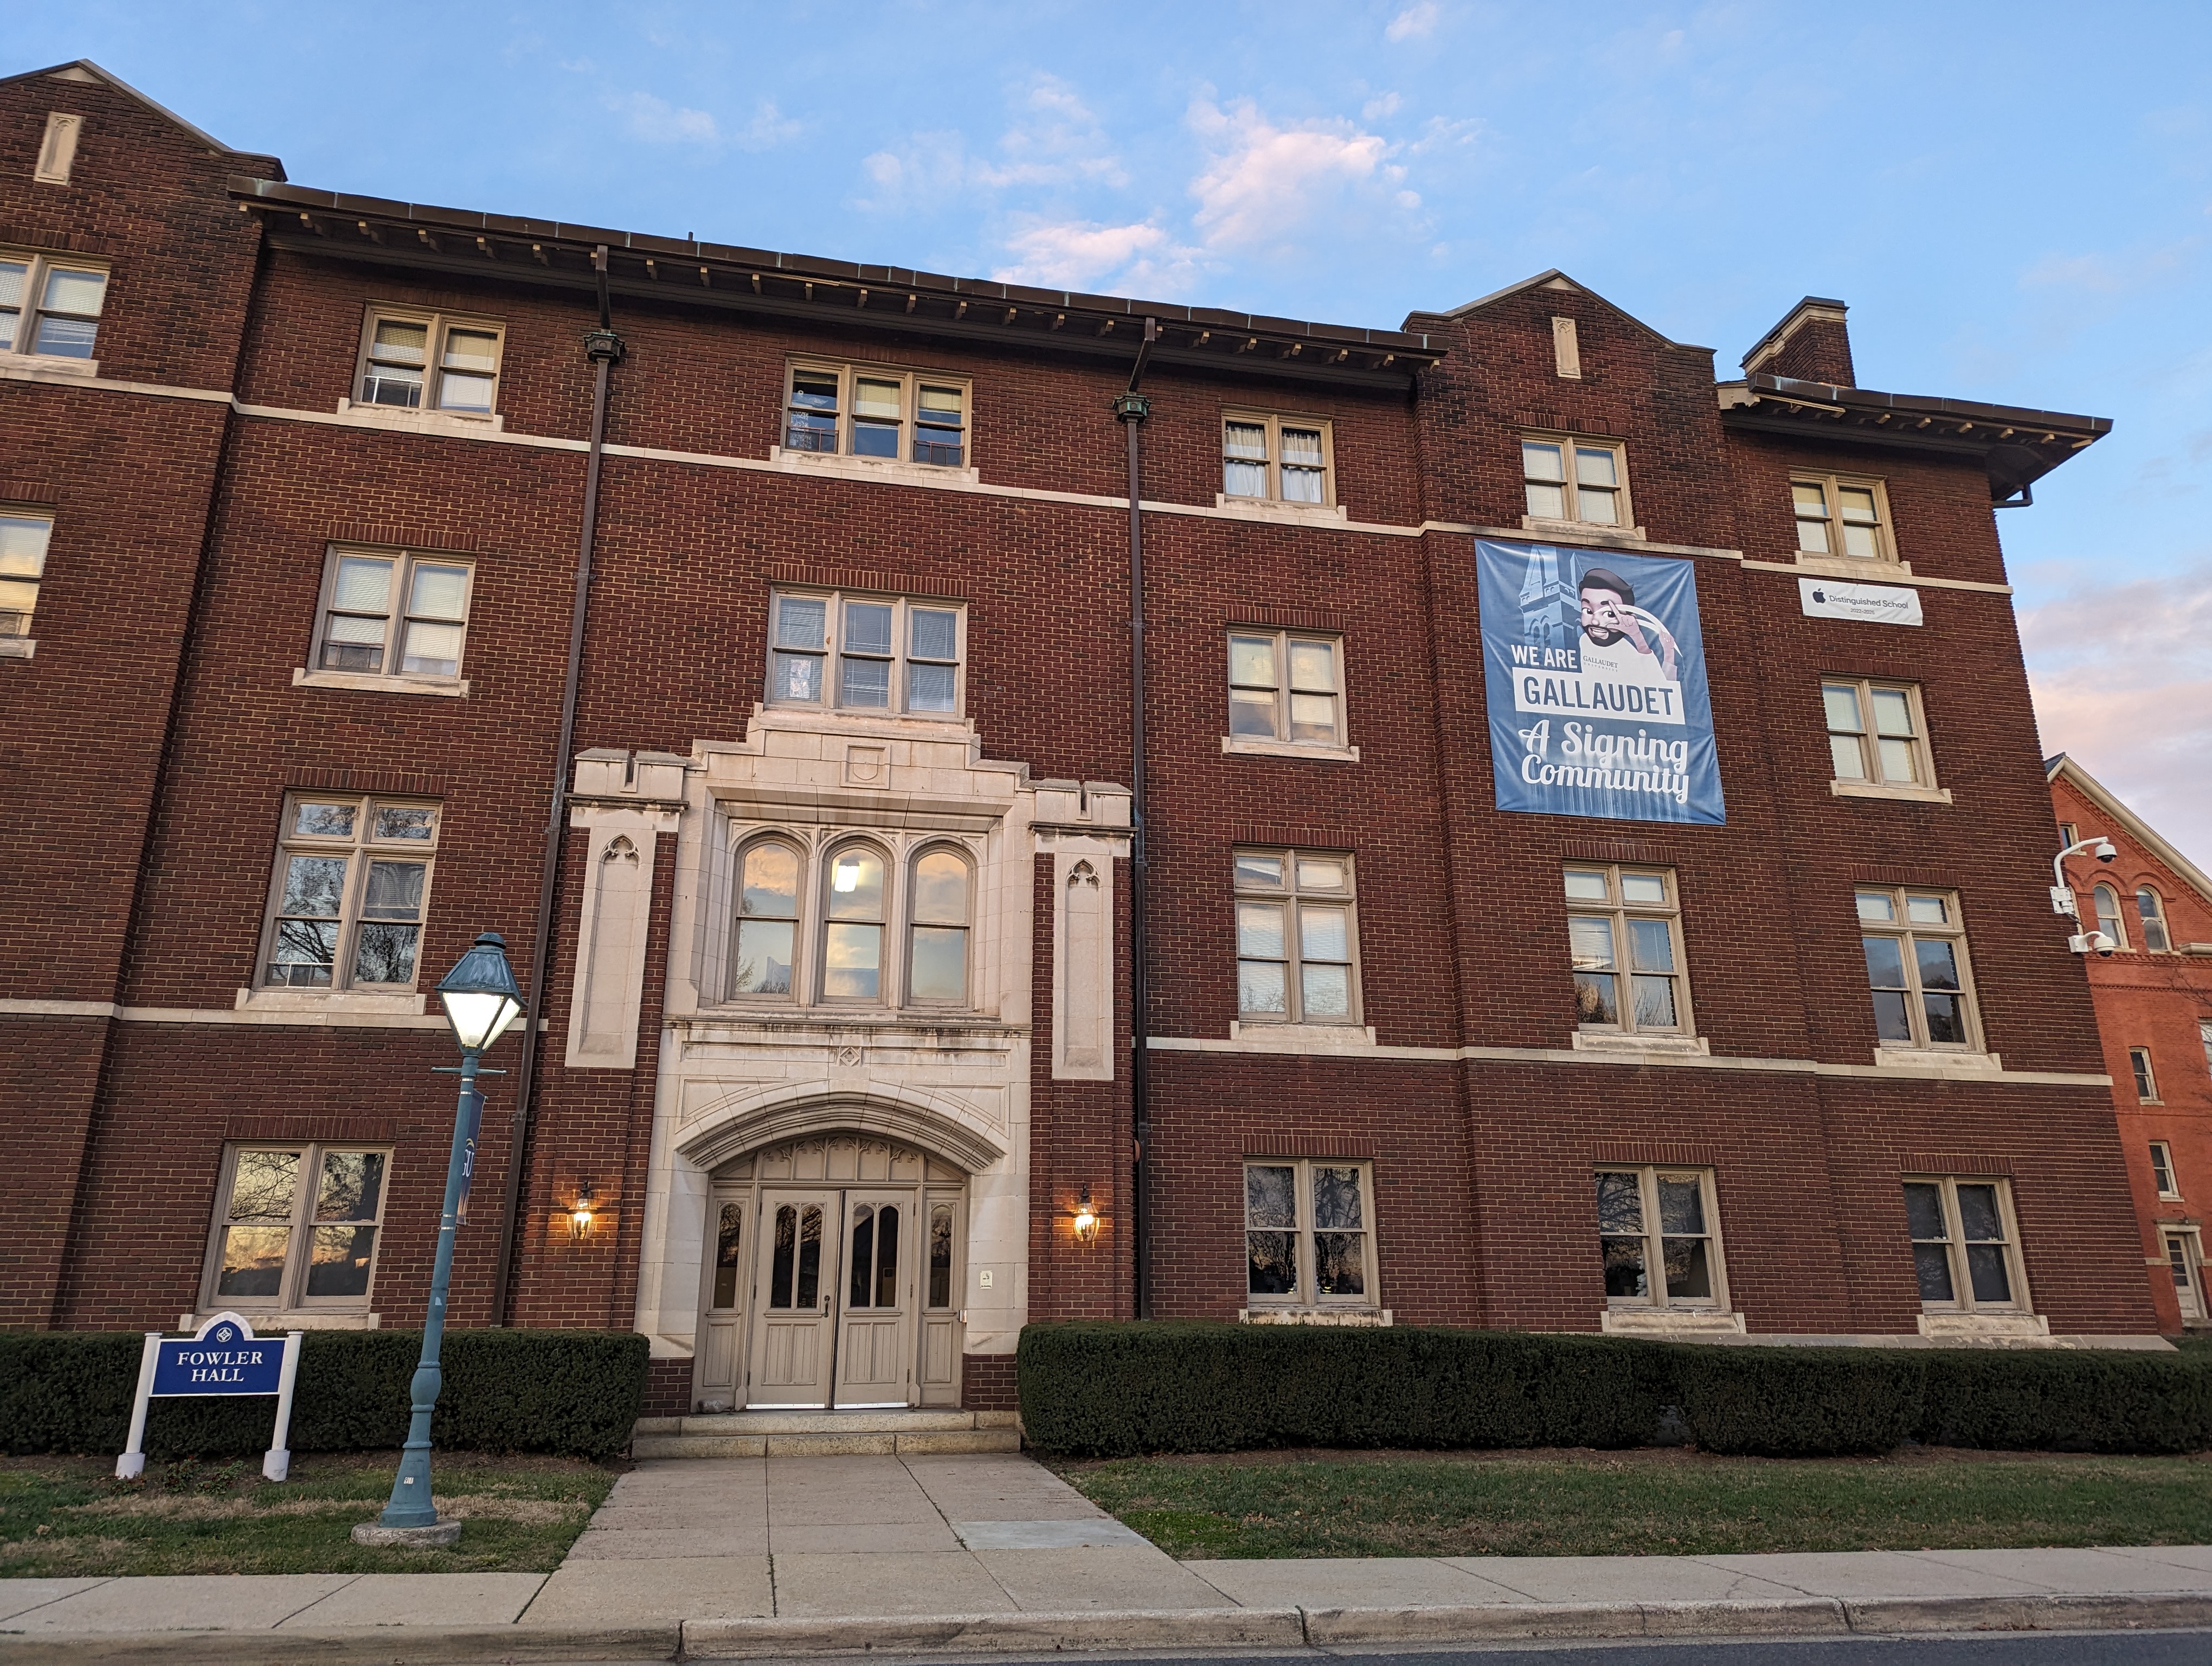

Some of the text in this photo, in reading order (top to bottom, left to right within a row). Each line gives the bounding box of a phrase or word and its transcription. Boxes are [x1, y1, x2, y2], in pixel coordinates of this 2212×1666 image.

[1829, 595, 1908, 608] Distinguished School
[1511, 644, 1578, 669] WE ARE
[1583, 655, 1618, 668] GALLAUDET
[1523, 676, 1674, 716] GALLAUDET
[1518, 719, 1688, 773] A Signing
[1521, 753, 1689, 804] Community
[176, 1351, 263, 1365] FOWLER
[190, 1368, 245, 1382] HALL
